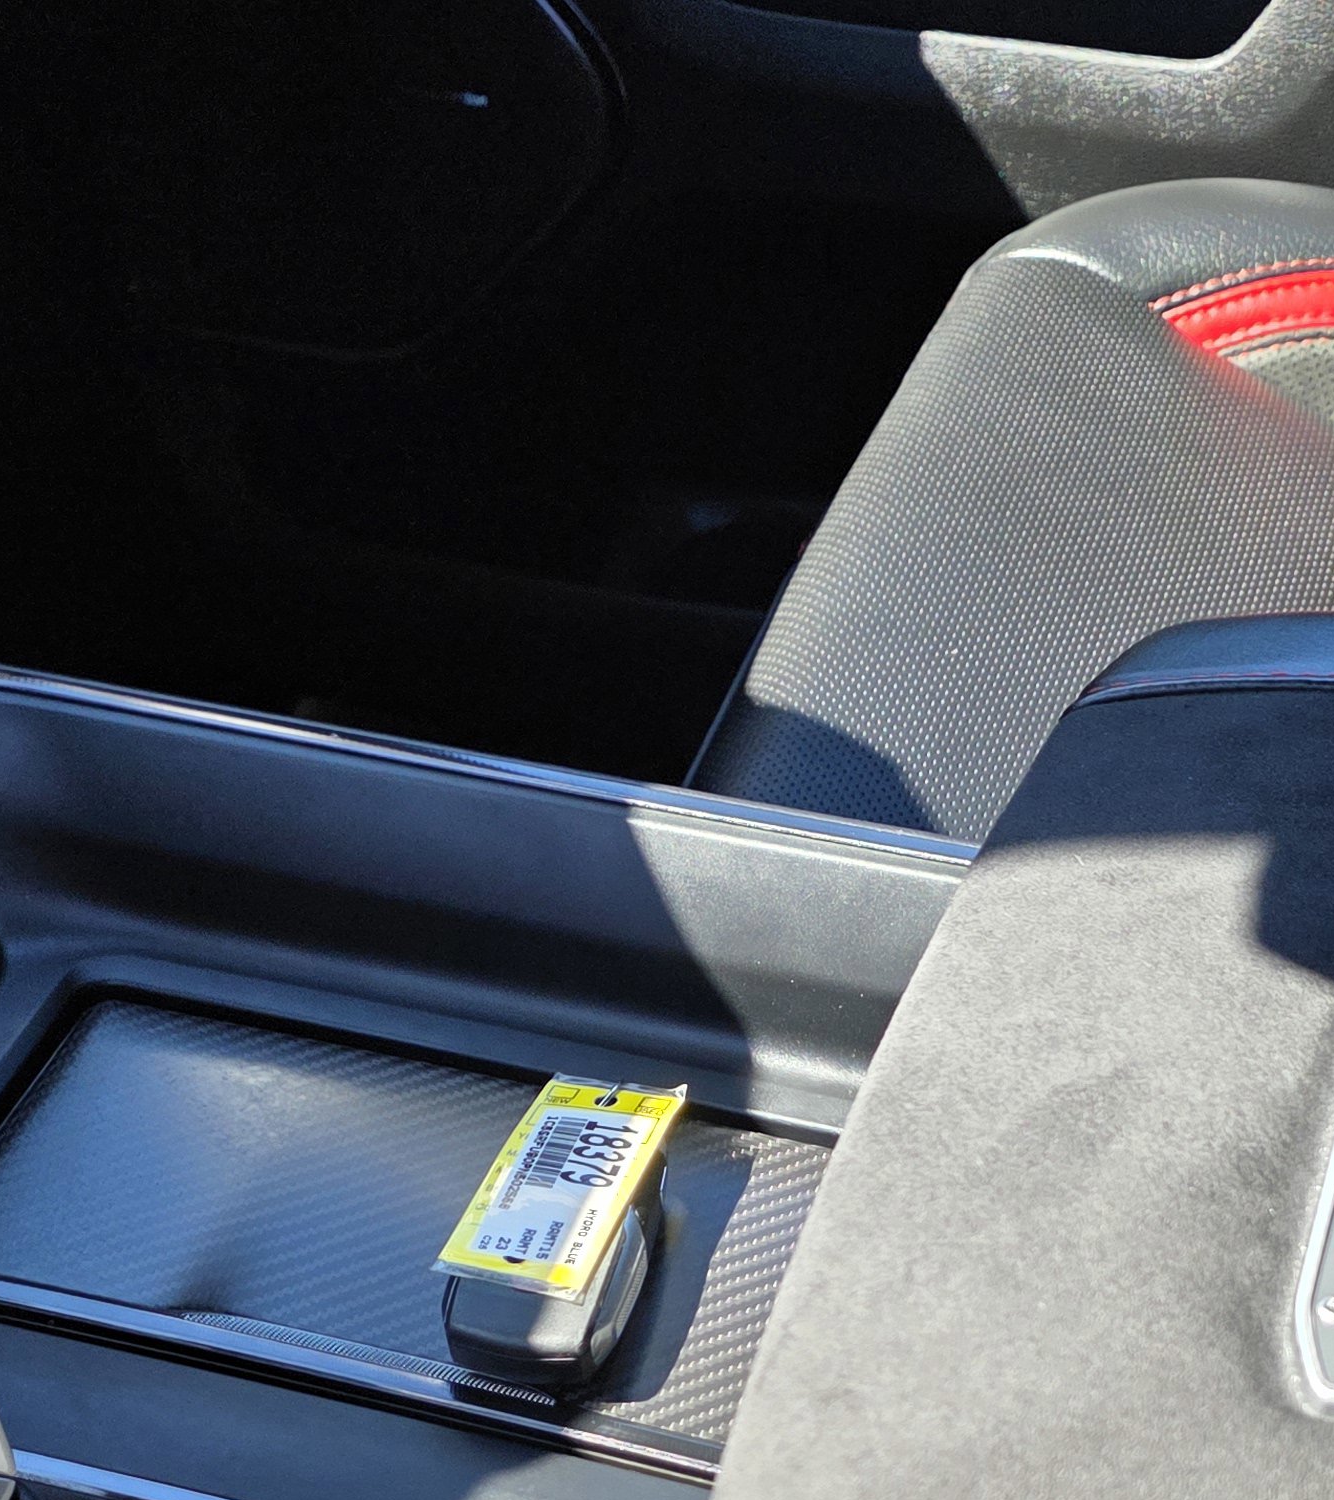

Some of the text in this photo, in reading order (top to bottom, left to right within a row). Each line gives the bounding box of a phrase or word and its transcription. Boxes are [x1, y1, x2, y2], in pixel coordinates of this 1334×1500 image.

[560, 1121, 638, 1187] 18379
[495, 1237, 512, 1250] 23
[515, 1228, 537, 1255] RAMT
[536, 1220, 564, 1260] RAMT15
[565, 1209, 598, 1264] HYDRO BLUE
